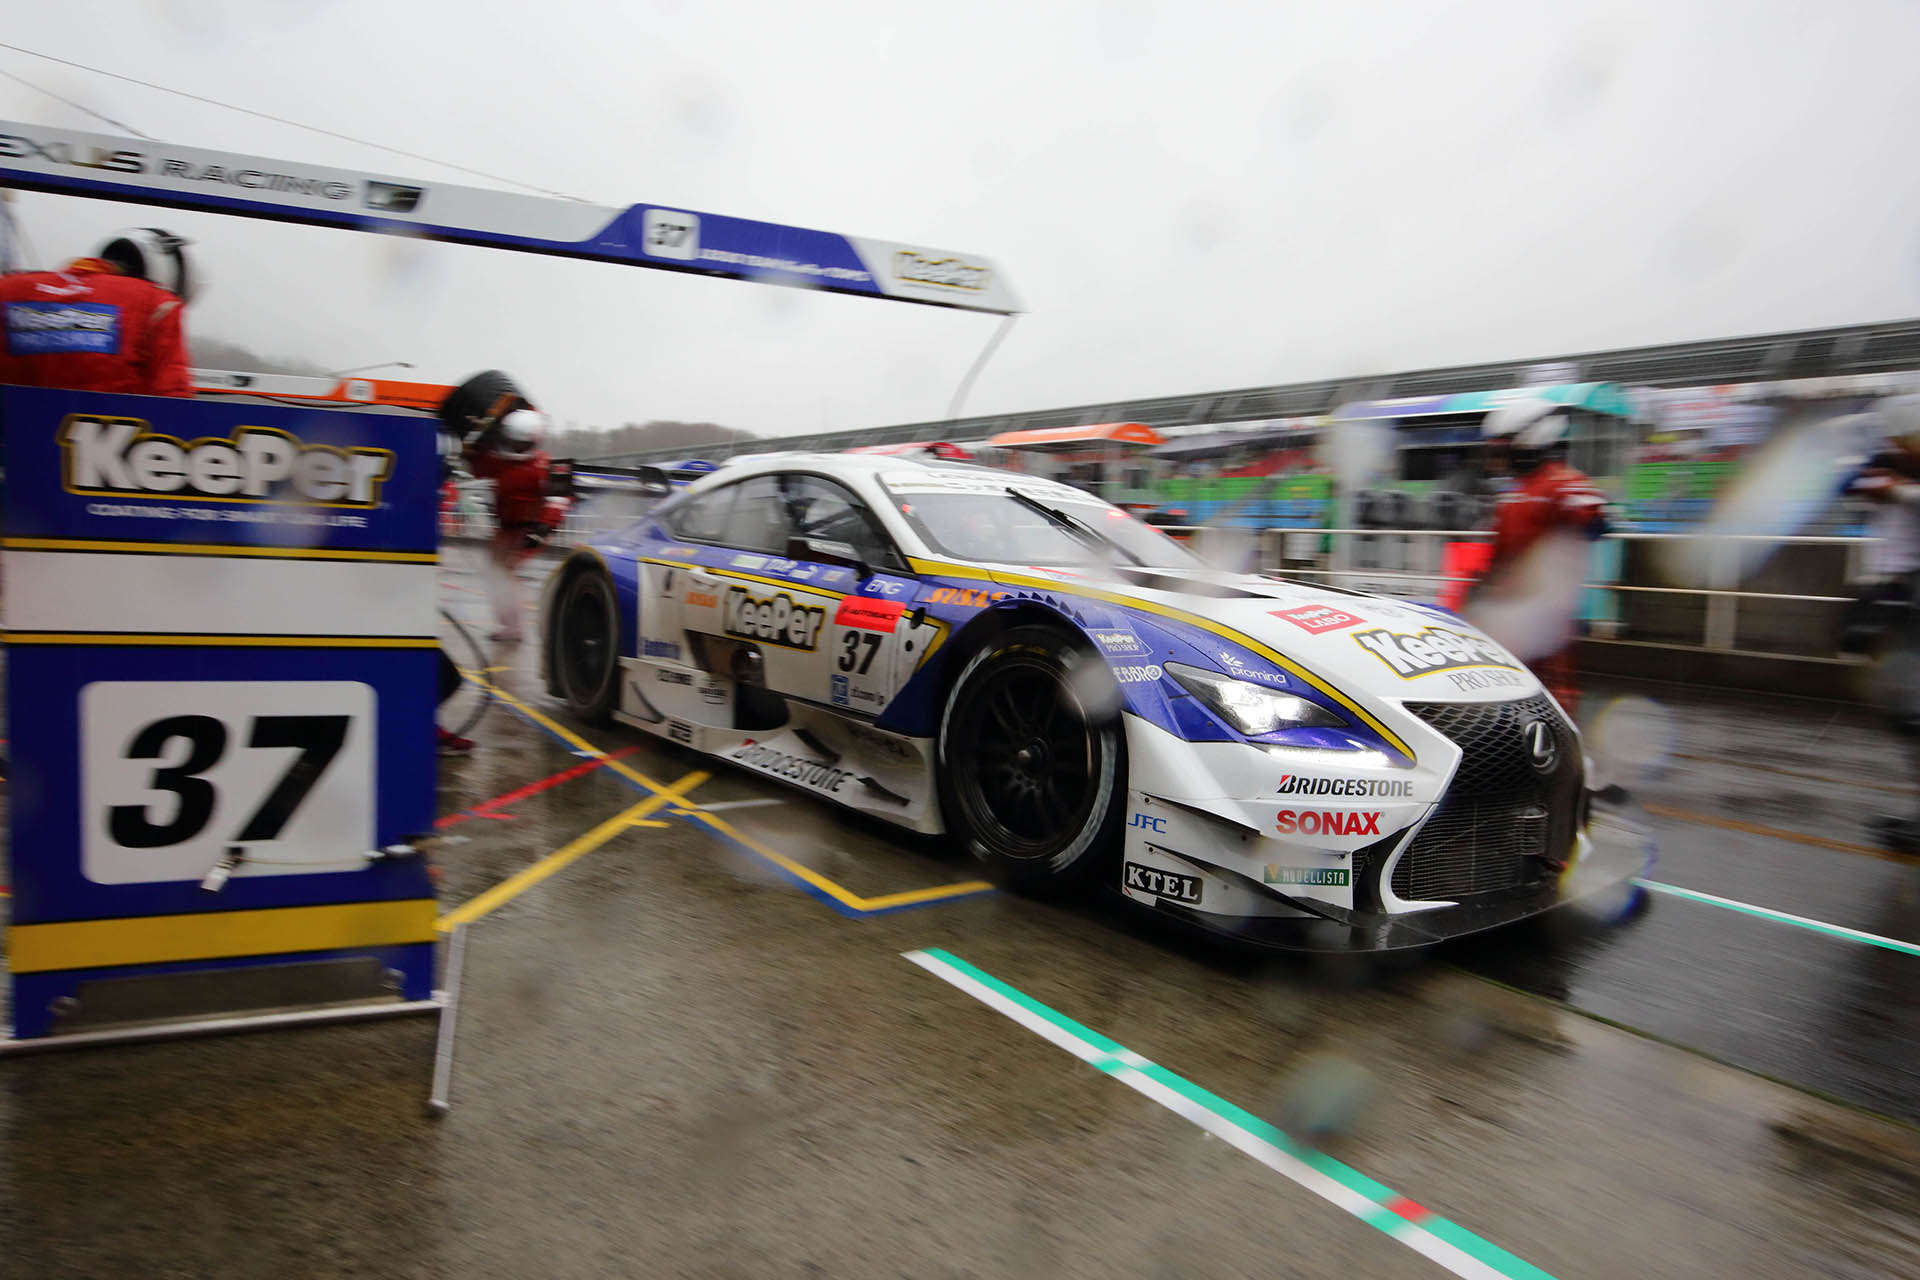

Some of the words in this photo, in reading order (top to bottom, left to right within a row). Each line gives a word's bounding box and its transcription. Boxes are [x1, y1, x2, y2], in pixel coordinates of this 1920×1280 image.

[161, 158, 354, 201] RACING
[62, 415, 390, 505] KeePer
[725, 586, 824, 649] KeePer
[1303, 613, 1351, 628] LABO
[838, 630, 883, 675] 37
[1230, 666, 1286, 684] promina
[1447, 671, 1490, 692] PRO
[107, 714, 352, 849] 37
[732, 746, 853, 793] BRIDGESTONE
[1276, 775, 1414, 797] BRIDGESTONE
[1128, 813, 1167, 834] JFC
[1276, 810, 1381, 836] SONAX
[1128, 865, 1199, 901] KTEL
